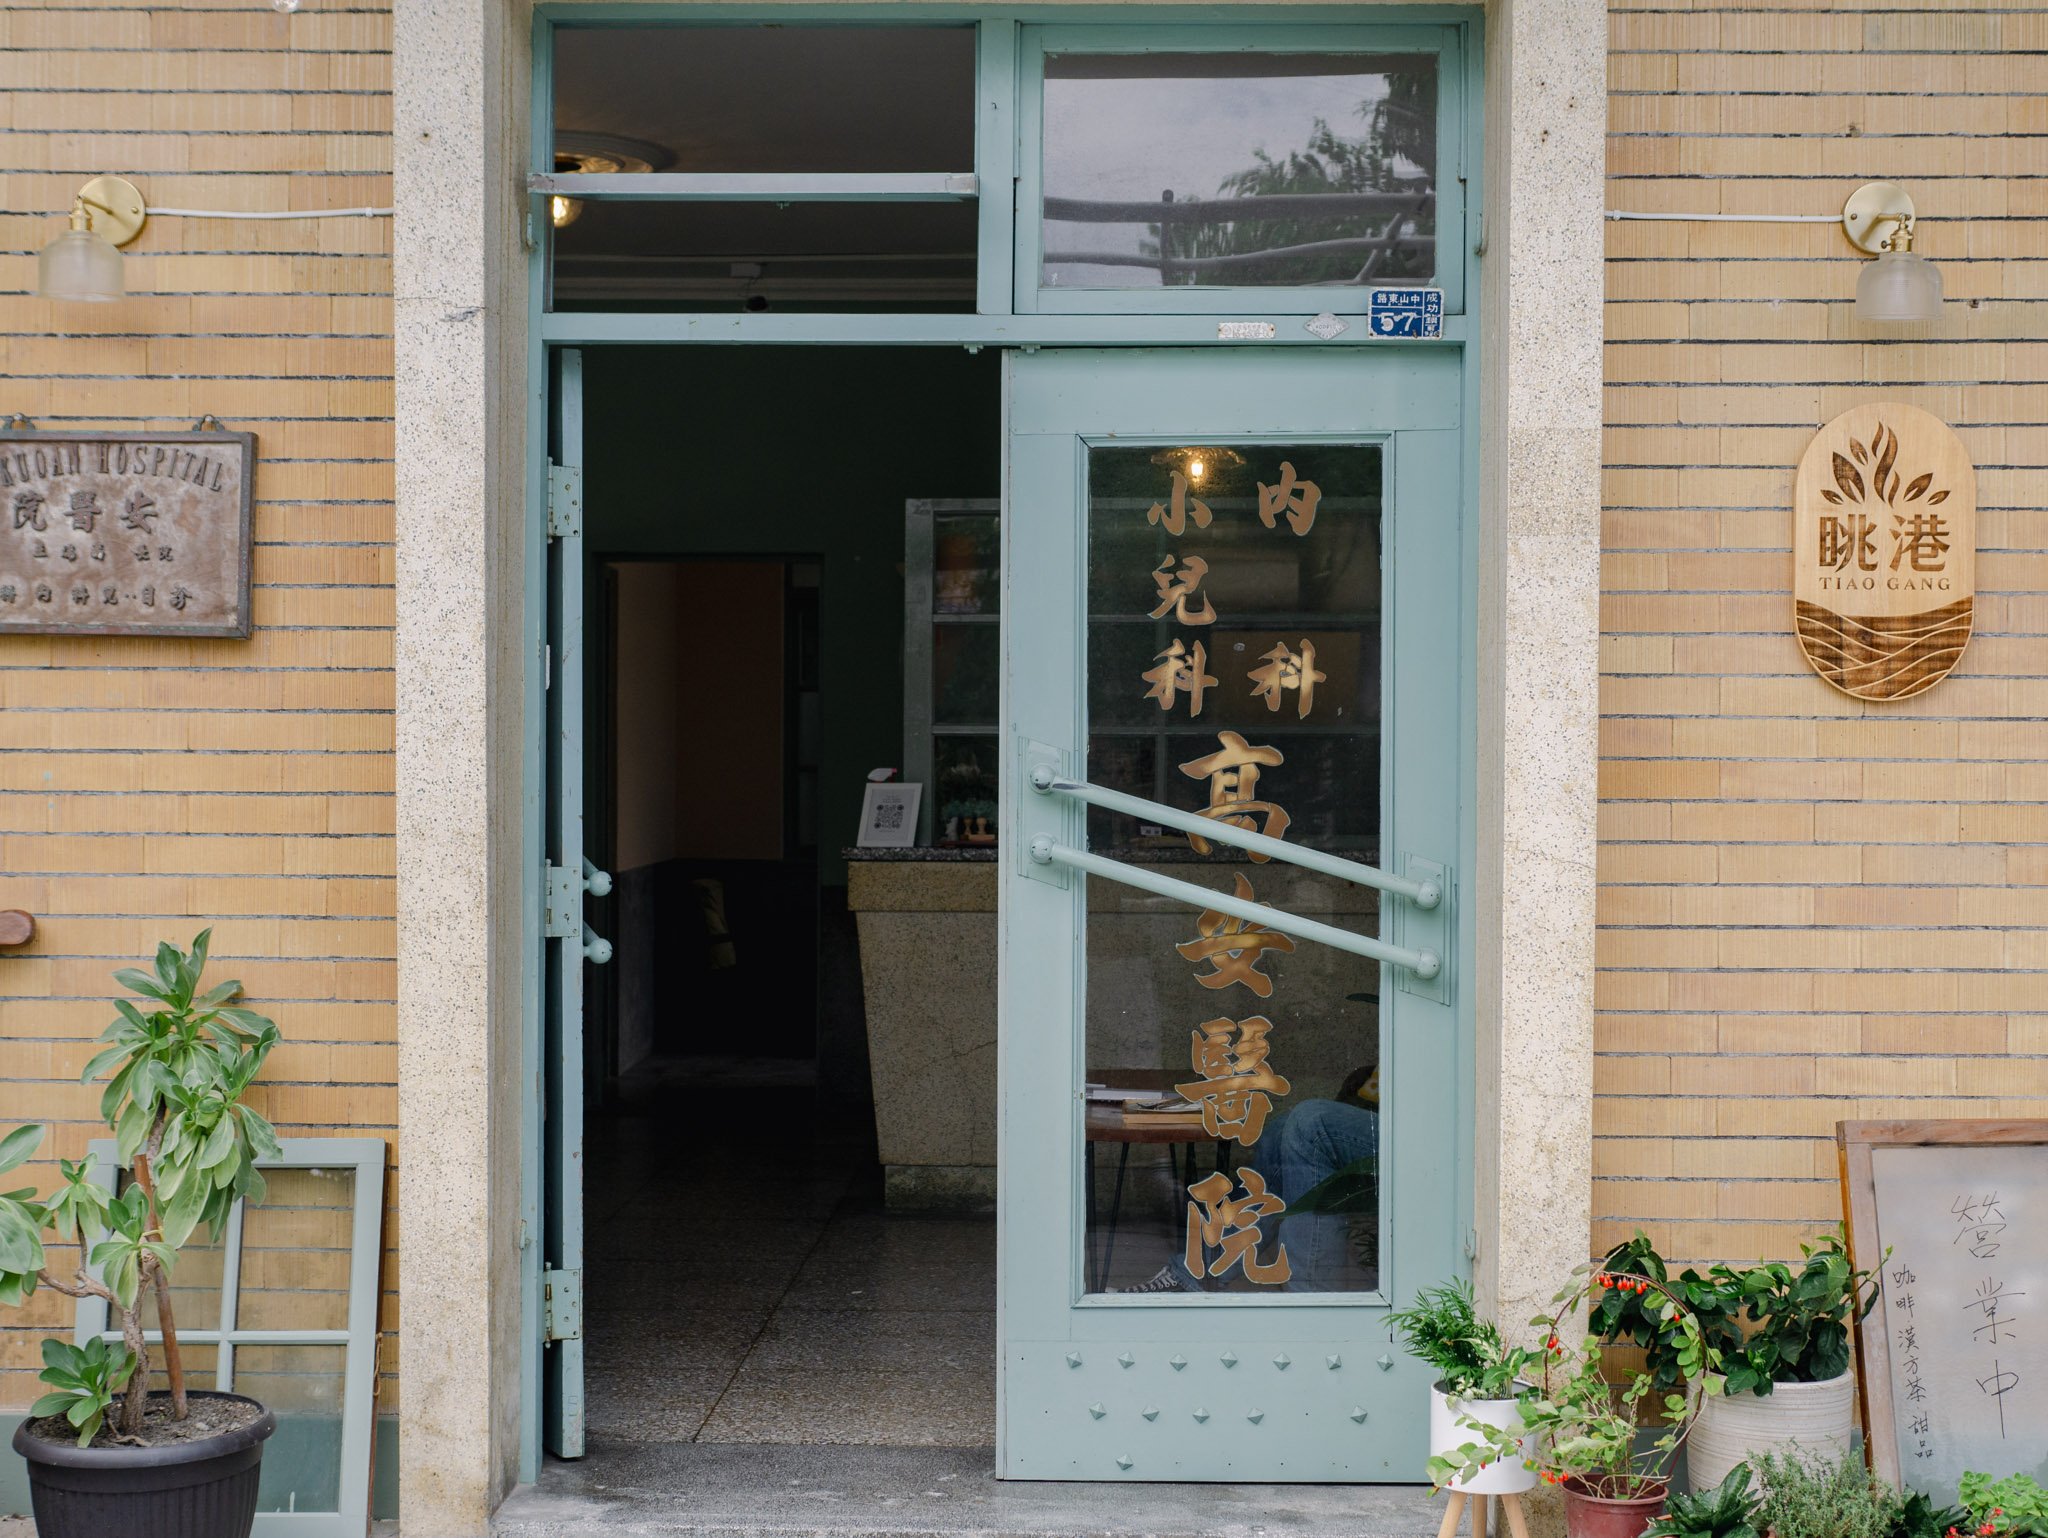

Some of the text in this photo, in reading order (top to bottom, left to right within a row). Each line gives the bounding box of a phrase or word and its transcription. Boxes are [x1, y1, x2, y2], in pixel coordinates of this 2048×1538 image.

[96, 443, 224, 492] HOSPITAL
[1819, 514, 1951, 572] 眺港
[1141, 470, 1219, 718] 小兒科
[1819, 576, 1951, 590] TIAO GANG
[1950, 1190, 2026, 1440] 營業中
